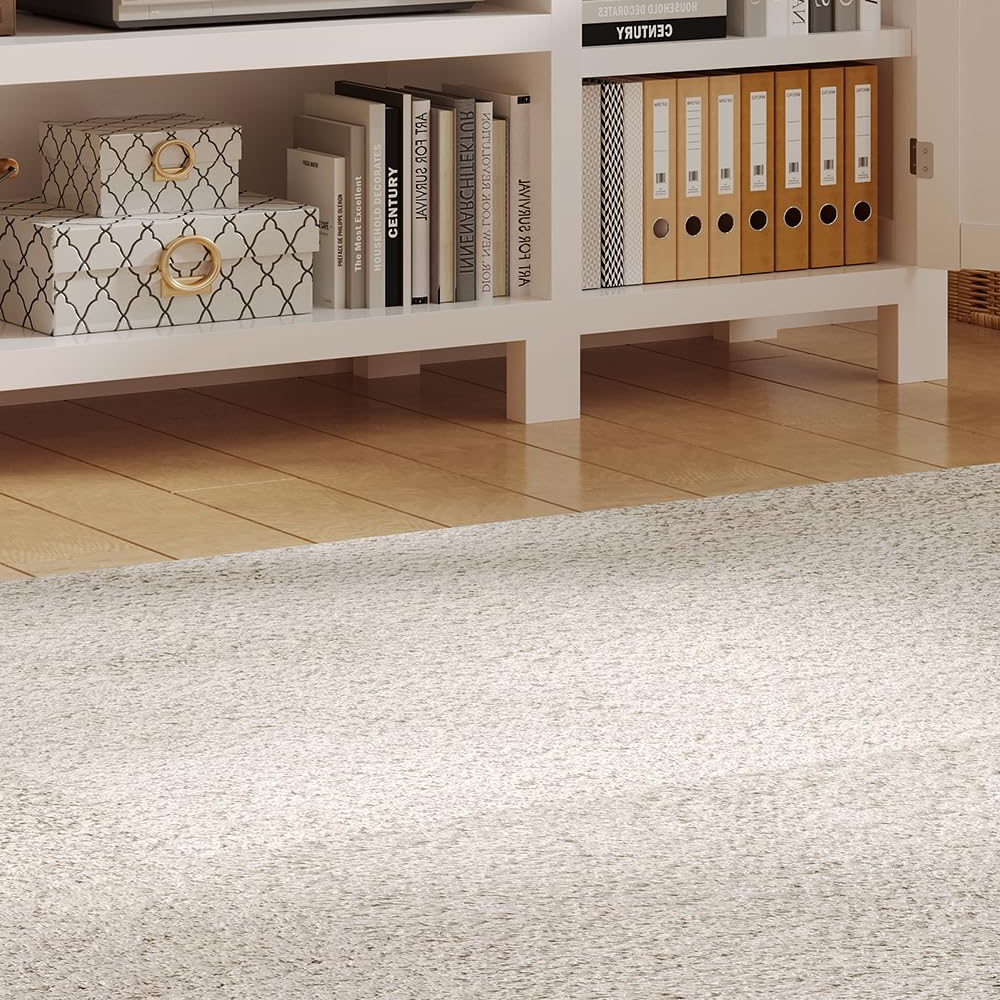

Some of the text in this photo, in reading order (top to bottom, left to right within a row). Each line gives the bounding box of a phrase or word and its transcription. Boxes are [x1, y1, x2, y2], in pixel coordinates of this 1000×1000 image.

[354, 176, 362, 223] Excellent
[373, 144, 382, 272] HOUSEHOLD DECORATES
[388, 167, 399, 239] CENTURY
